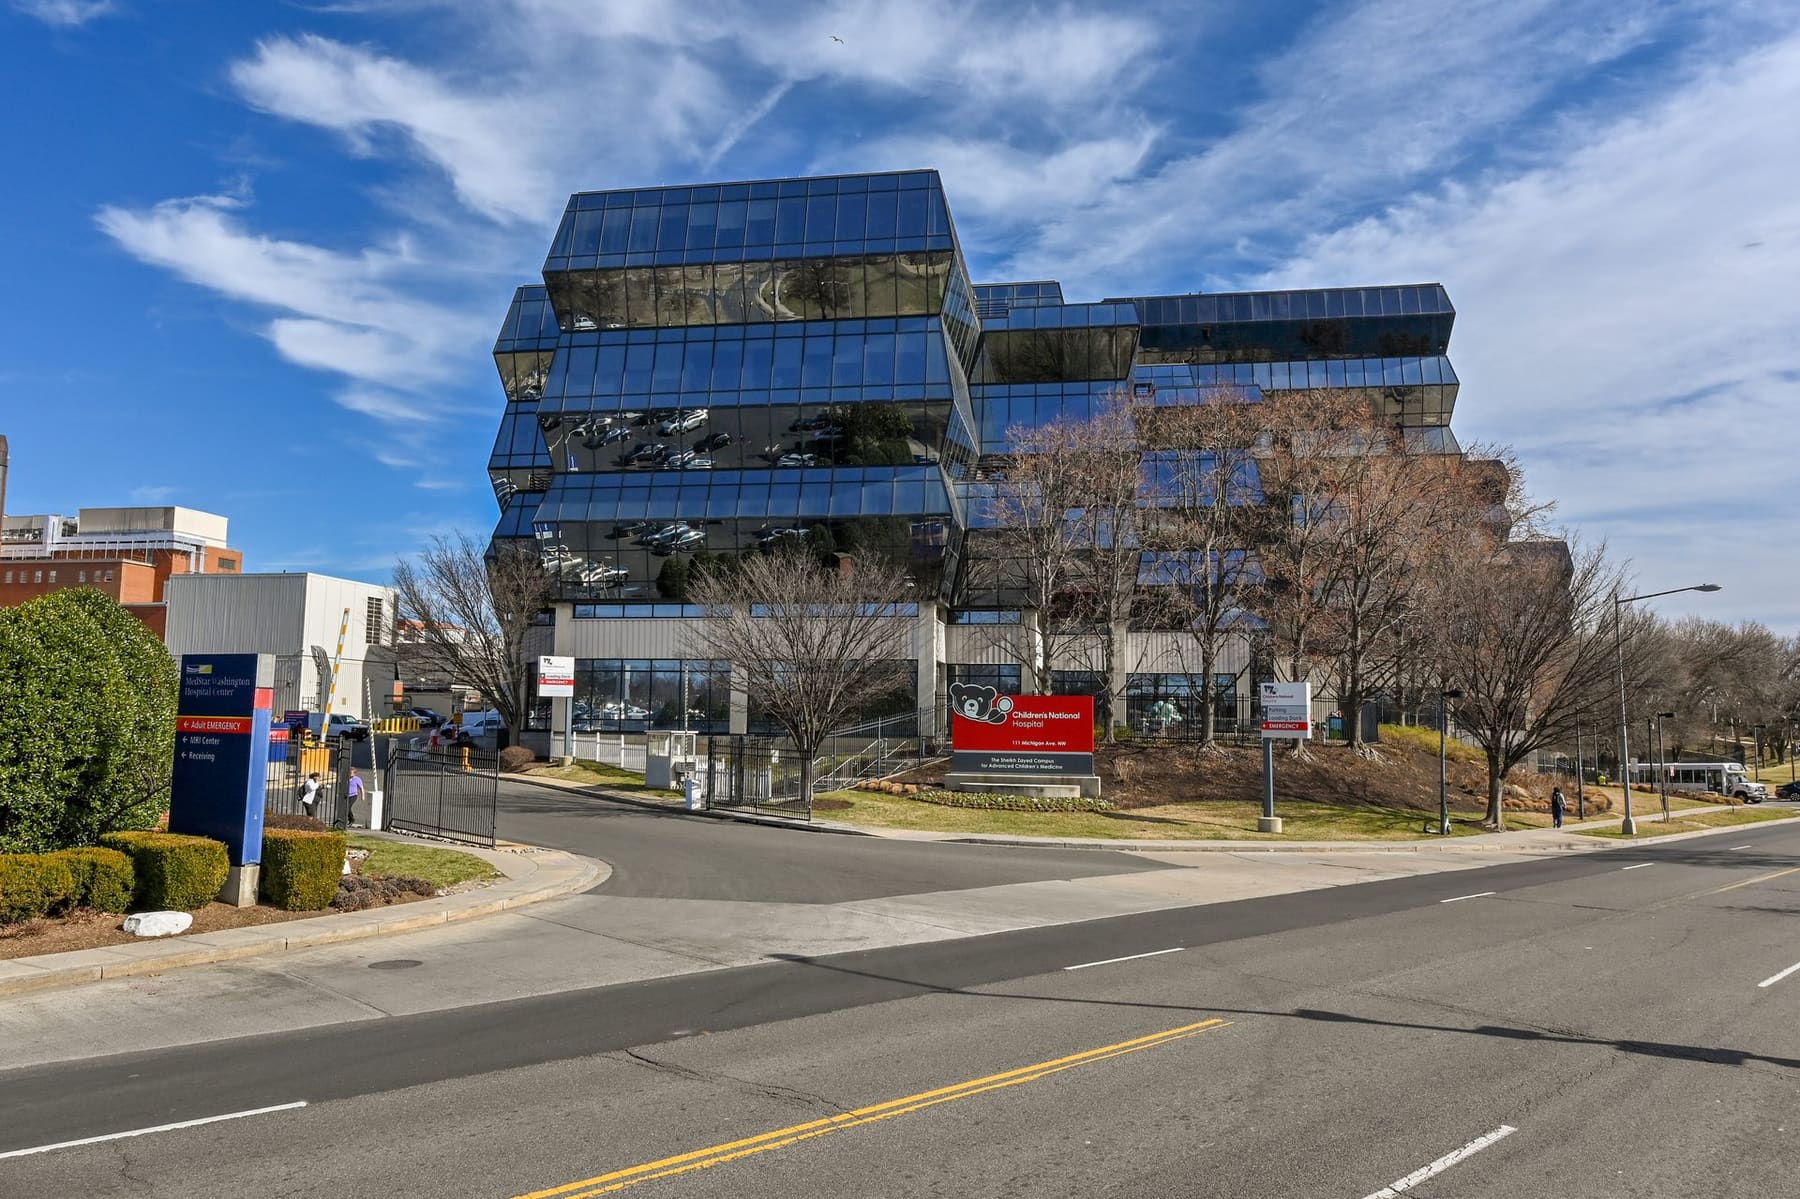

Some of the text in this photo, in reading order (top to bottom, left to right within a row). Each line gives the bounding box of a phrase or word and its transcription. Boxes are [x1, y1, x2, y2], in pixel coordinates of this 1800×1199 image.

[186, 677, 250, 687] MedStar Washington
[185, 687, 234, 698] Hospital Center
[1012, 711, 1080, 719] Children's National
[191, 721, 241, 730] Adult EMERGENCY
[1012, 720, 1044, 728] Hospital
[190, 736, 220, 745] MRI Center
[189, 751, 215, 762] Receiving
